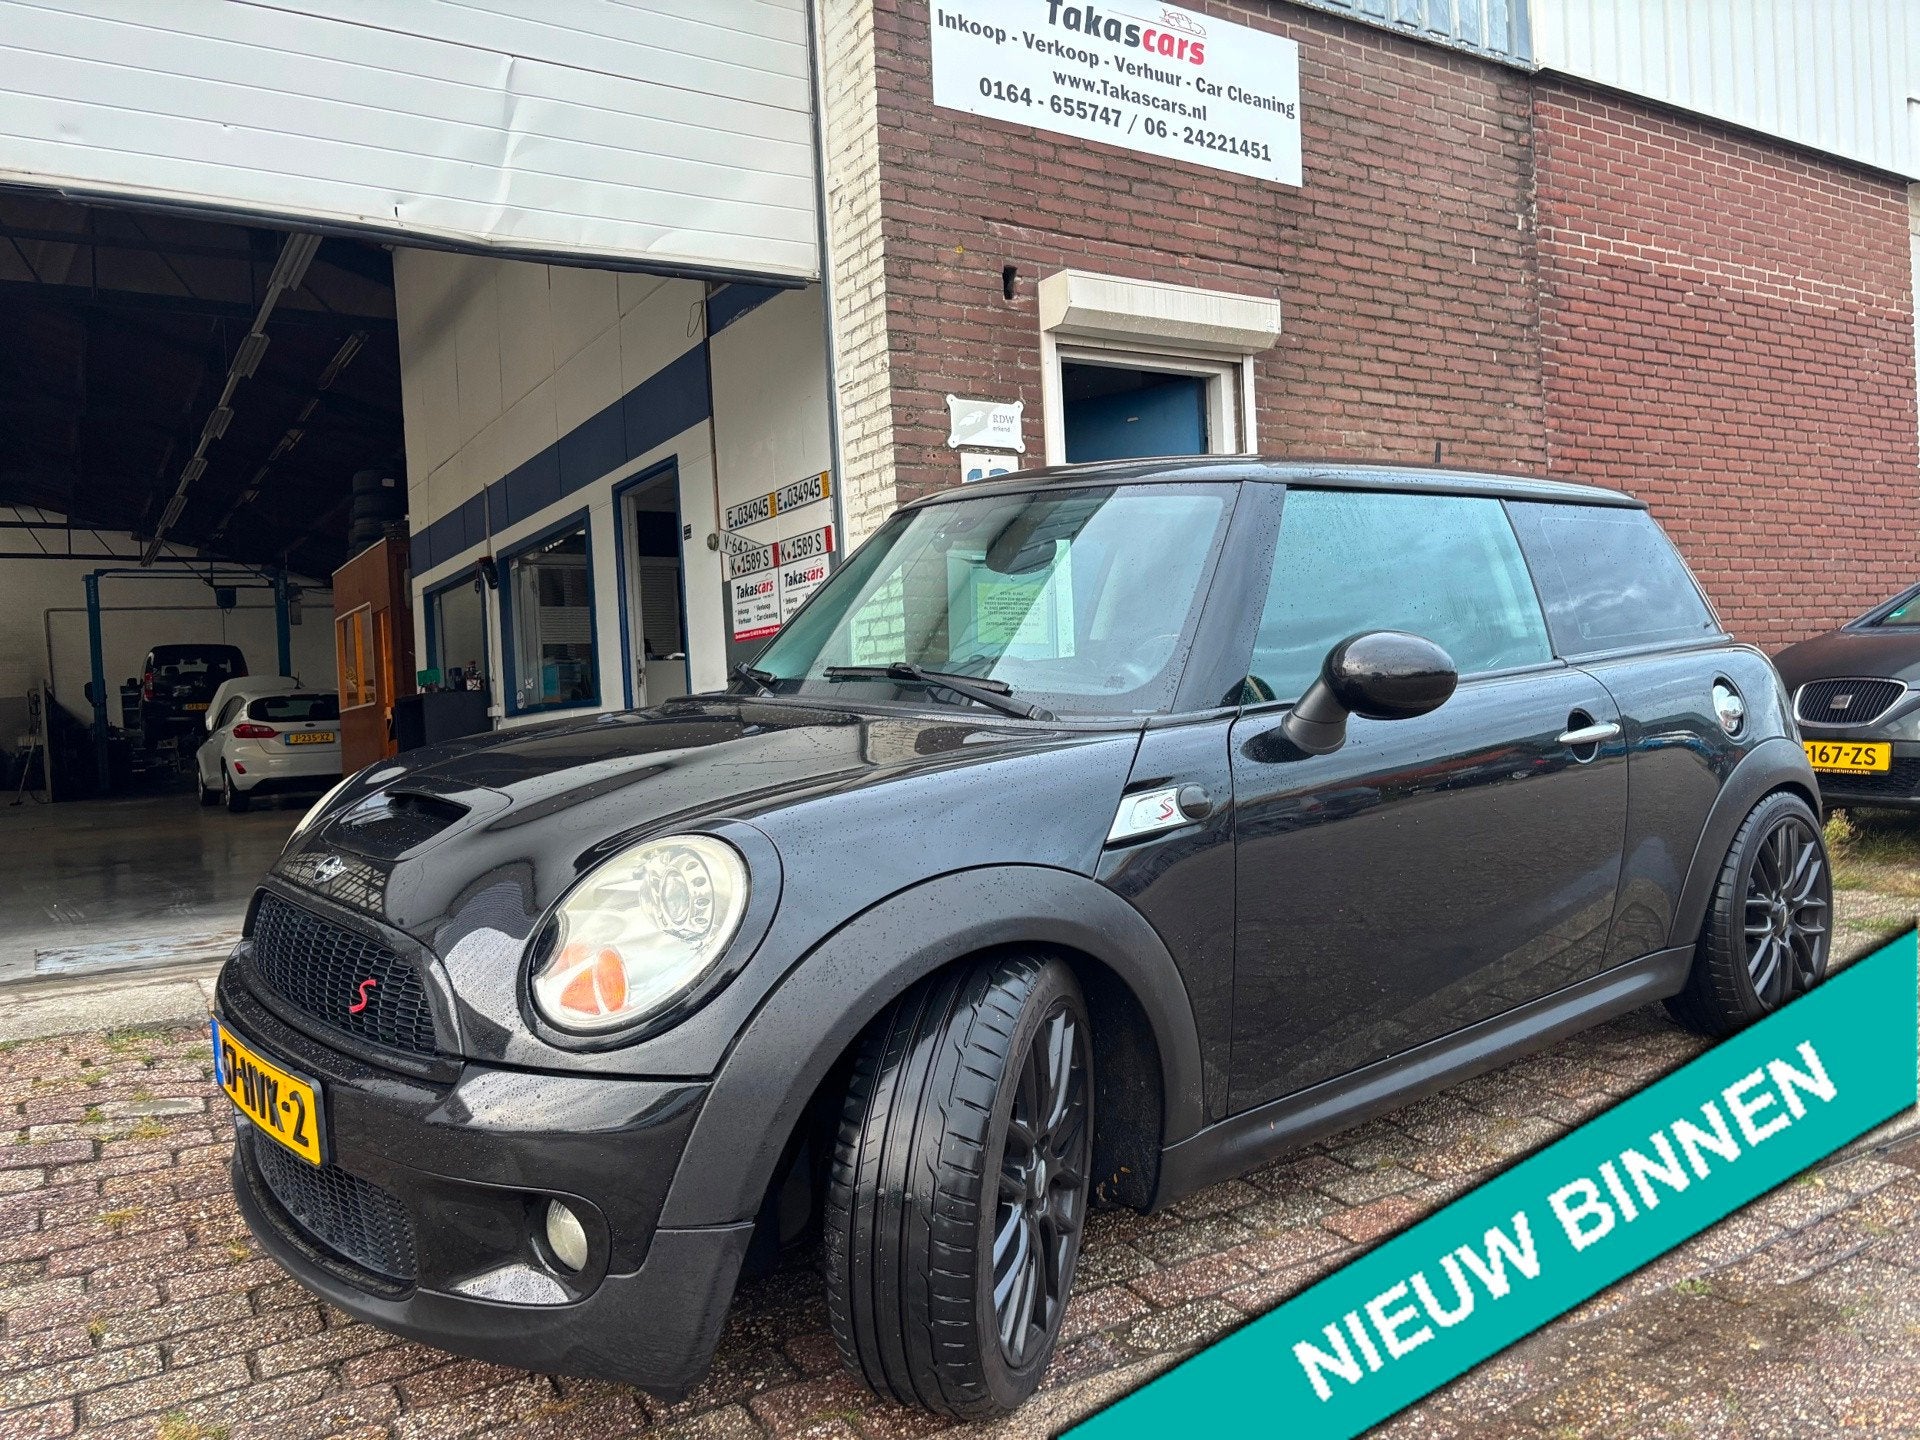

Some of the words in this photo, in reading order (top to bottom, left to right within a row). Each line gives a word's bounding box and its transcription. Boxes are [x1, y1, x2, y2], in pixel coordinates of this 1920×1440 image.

[1046, 0, 1206, 66] Takascars
[937, 8, 1007, 45] Inkoop
[1022, 30, 1100, 70] Verkoop
[1114, 56, 1182, 89] Verhuur
[1195, 77, 1223, 98] Car
[1227, 85, 1295, 120] Cleaning
[1052, 70, 1208, 121] www.Takascars.nl
[979, 76, 1033, 107] 0164
[1050, 94, 1122, 128] 655747
[1127, 114, 1138, 134] /
[1144, 116, 1168, 139] 06
[1183, 125, 1272, 162] 24221451
[993, 414, 1015, 424] RDW
[736, 579, 774, 600] Takascars
[784, 566, 824, 587] Takascars
[348, 978, 377, 1013] S
